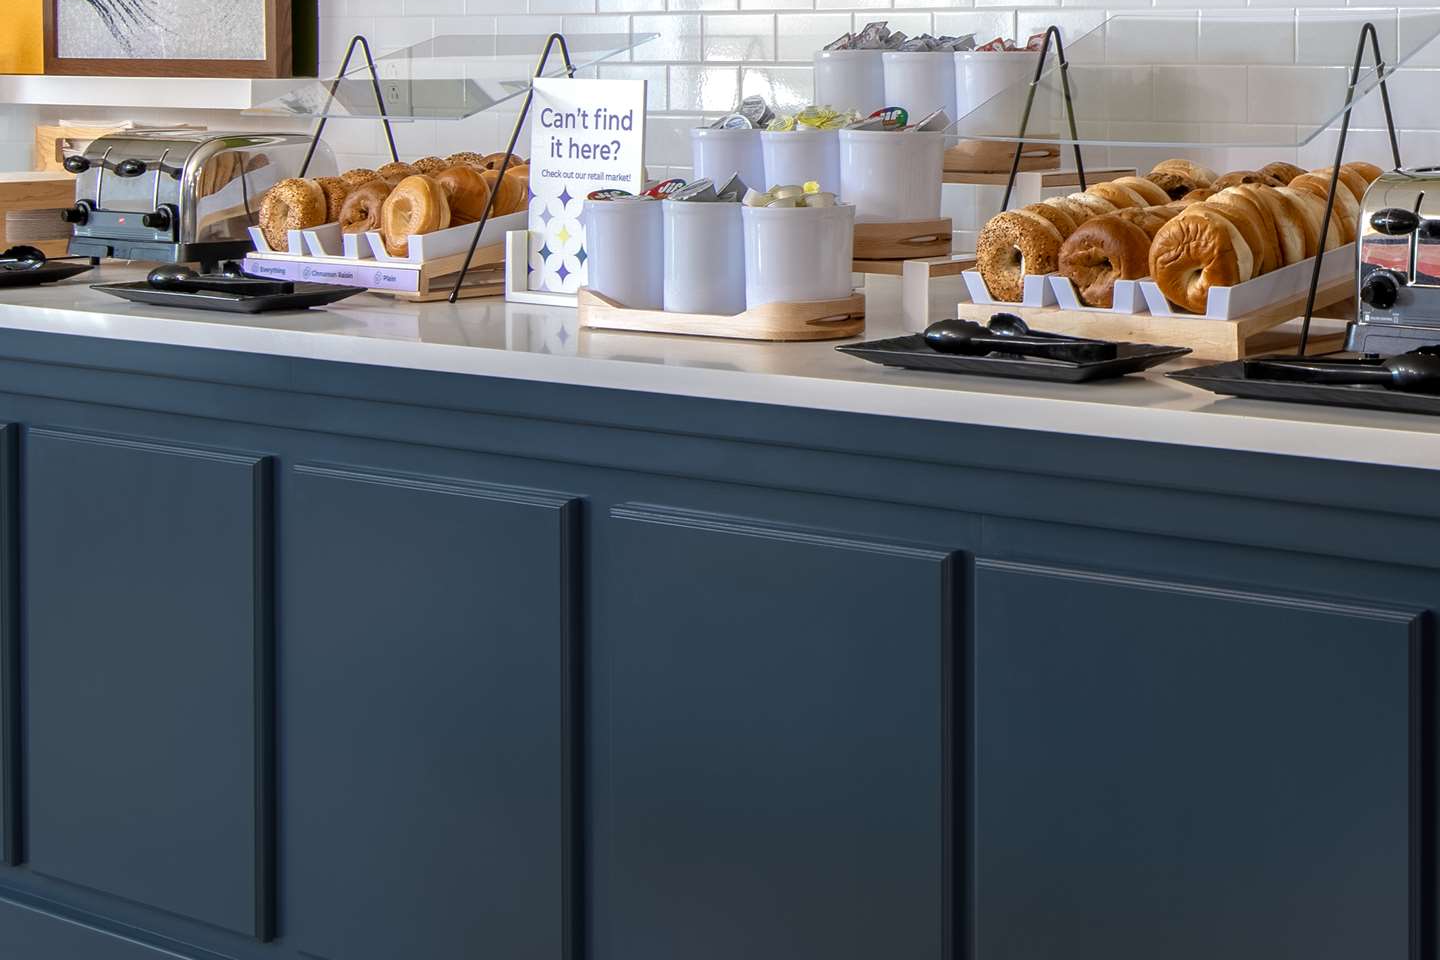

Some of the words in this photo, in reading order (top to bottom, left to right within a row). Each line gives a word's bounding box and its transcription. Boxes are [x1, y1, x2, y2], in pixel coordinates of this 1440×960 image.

[541, 107, 588, 130] Can’t
[594, 108, 633, 131] find
[551, 136, 563, 158] it
[569, 137, 621, 161] here?
[541, 169, 562, 178] Check
[562, 171, 575, 179] out
[587, 172, 605, 181] retail
[605, 173, 632, 182] market!
